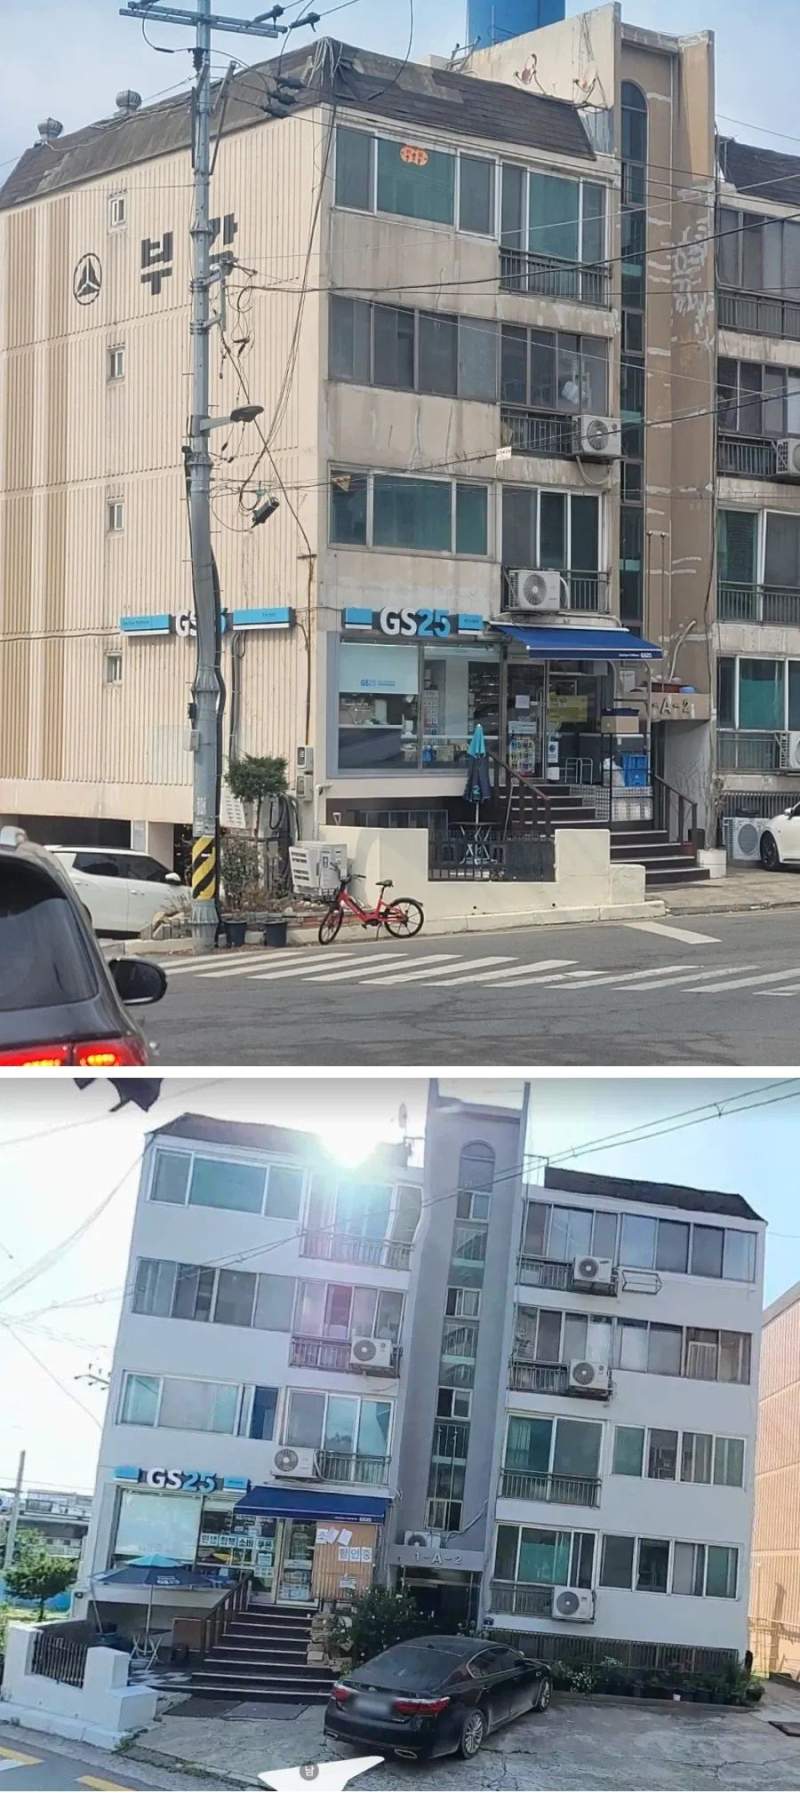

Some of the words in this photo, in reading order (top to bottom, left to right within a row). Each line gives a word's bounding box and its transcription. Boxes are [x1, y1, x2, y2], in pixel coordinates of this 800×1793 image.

[380, 607, 450, 637] GS25
[146, 1467, 216, 1493] GS25
[415, 1551, 463, 1566] 1-A-2
